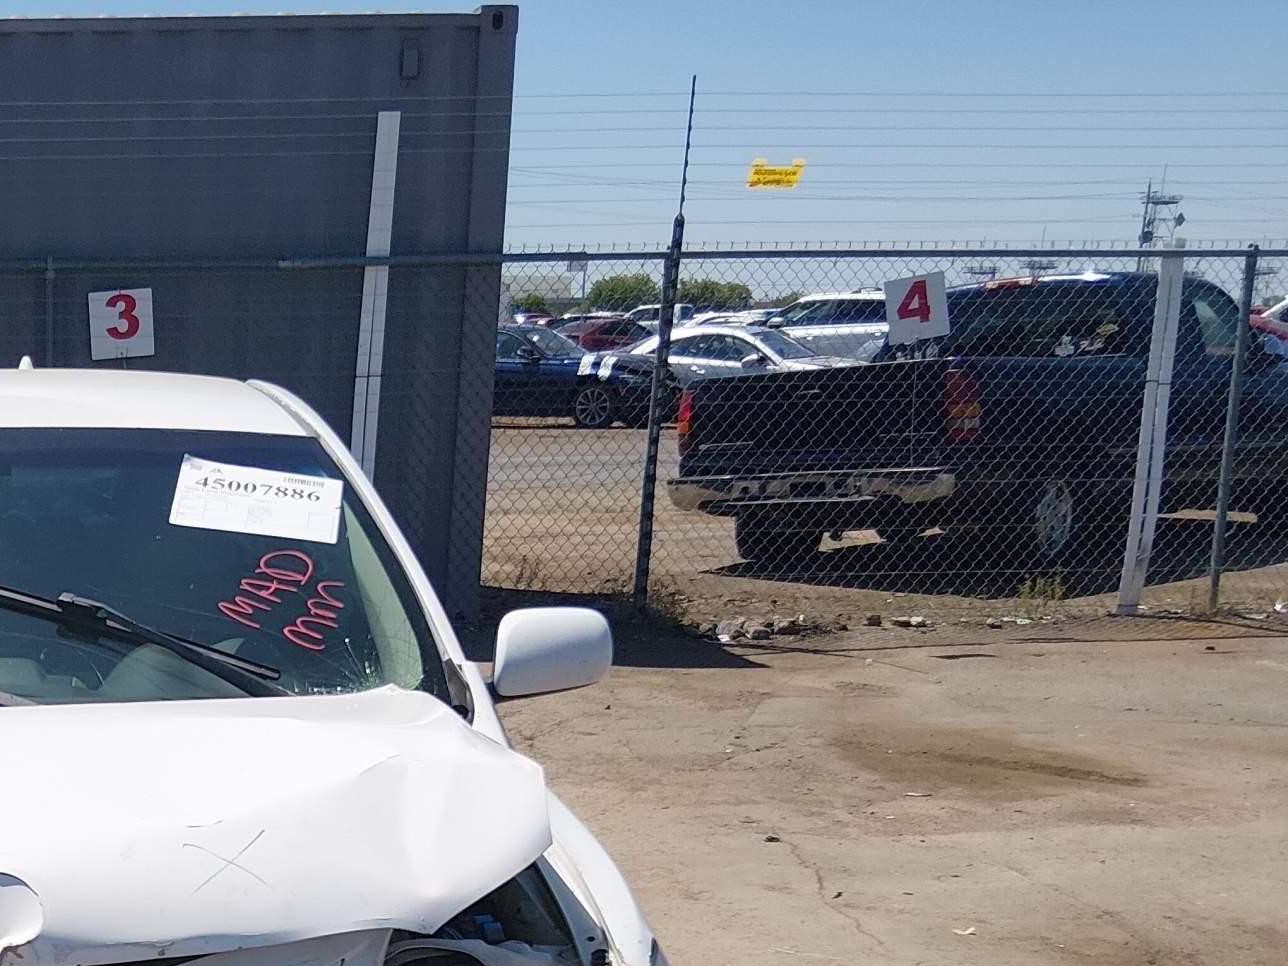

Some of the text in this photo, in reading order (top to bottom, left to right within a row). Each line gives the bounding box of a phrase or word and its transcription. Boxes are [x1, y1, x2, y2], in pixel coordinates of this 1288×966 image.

[105, 293, 140, 340] 3
[896, 279, 931, 323] 4
[194, 476, 321, 503] 45007886
[217, 550, 313, 629] MAD
